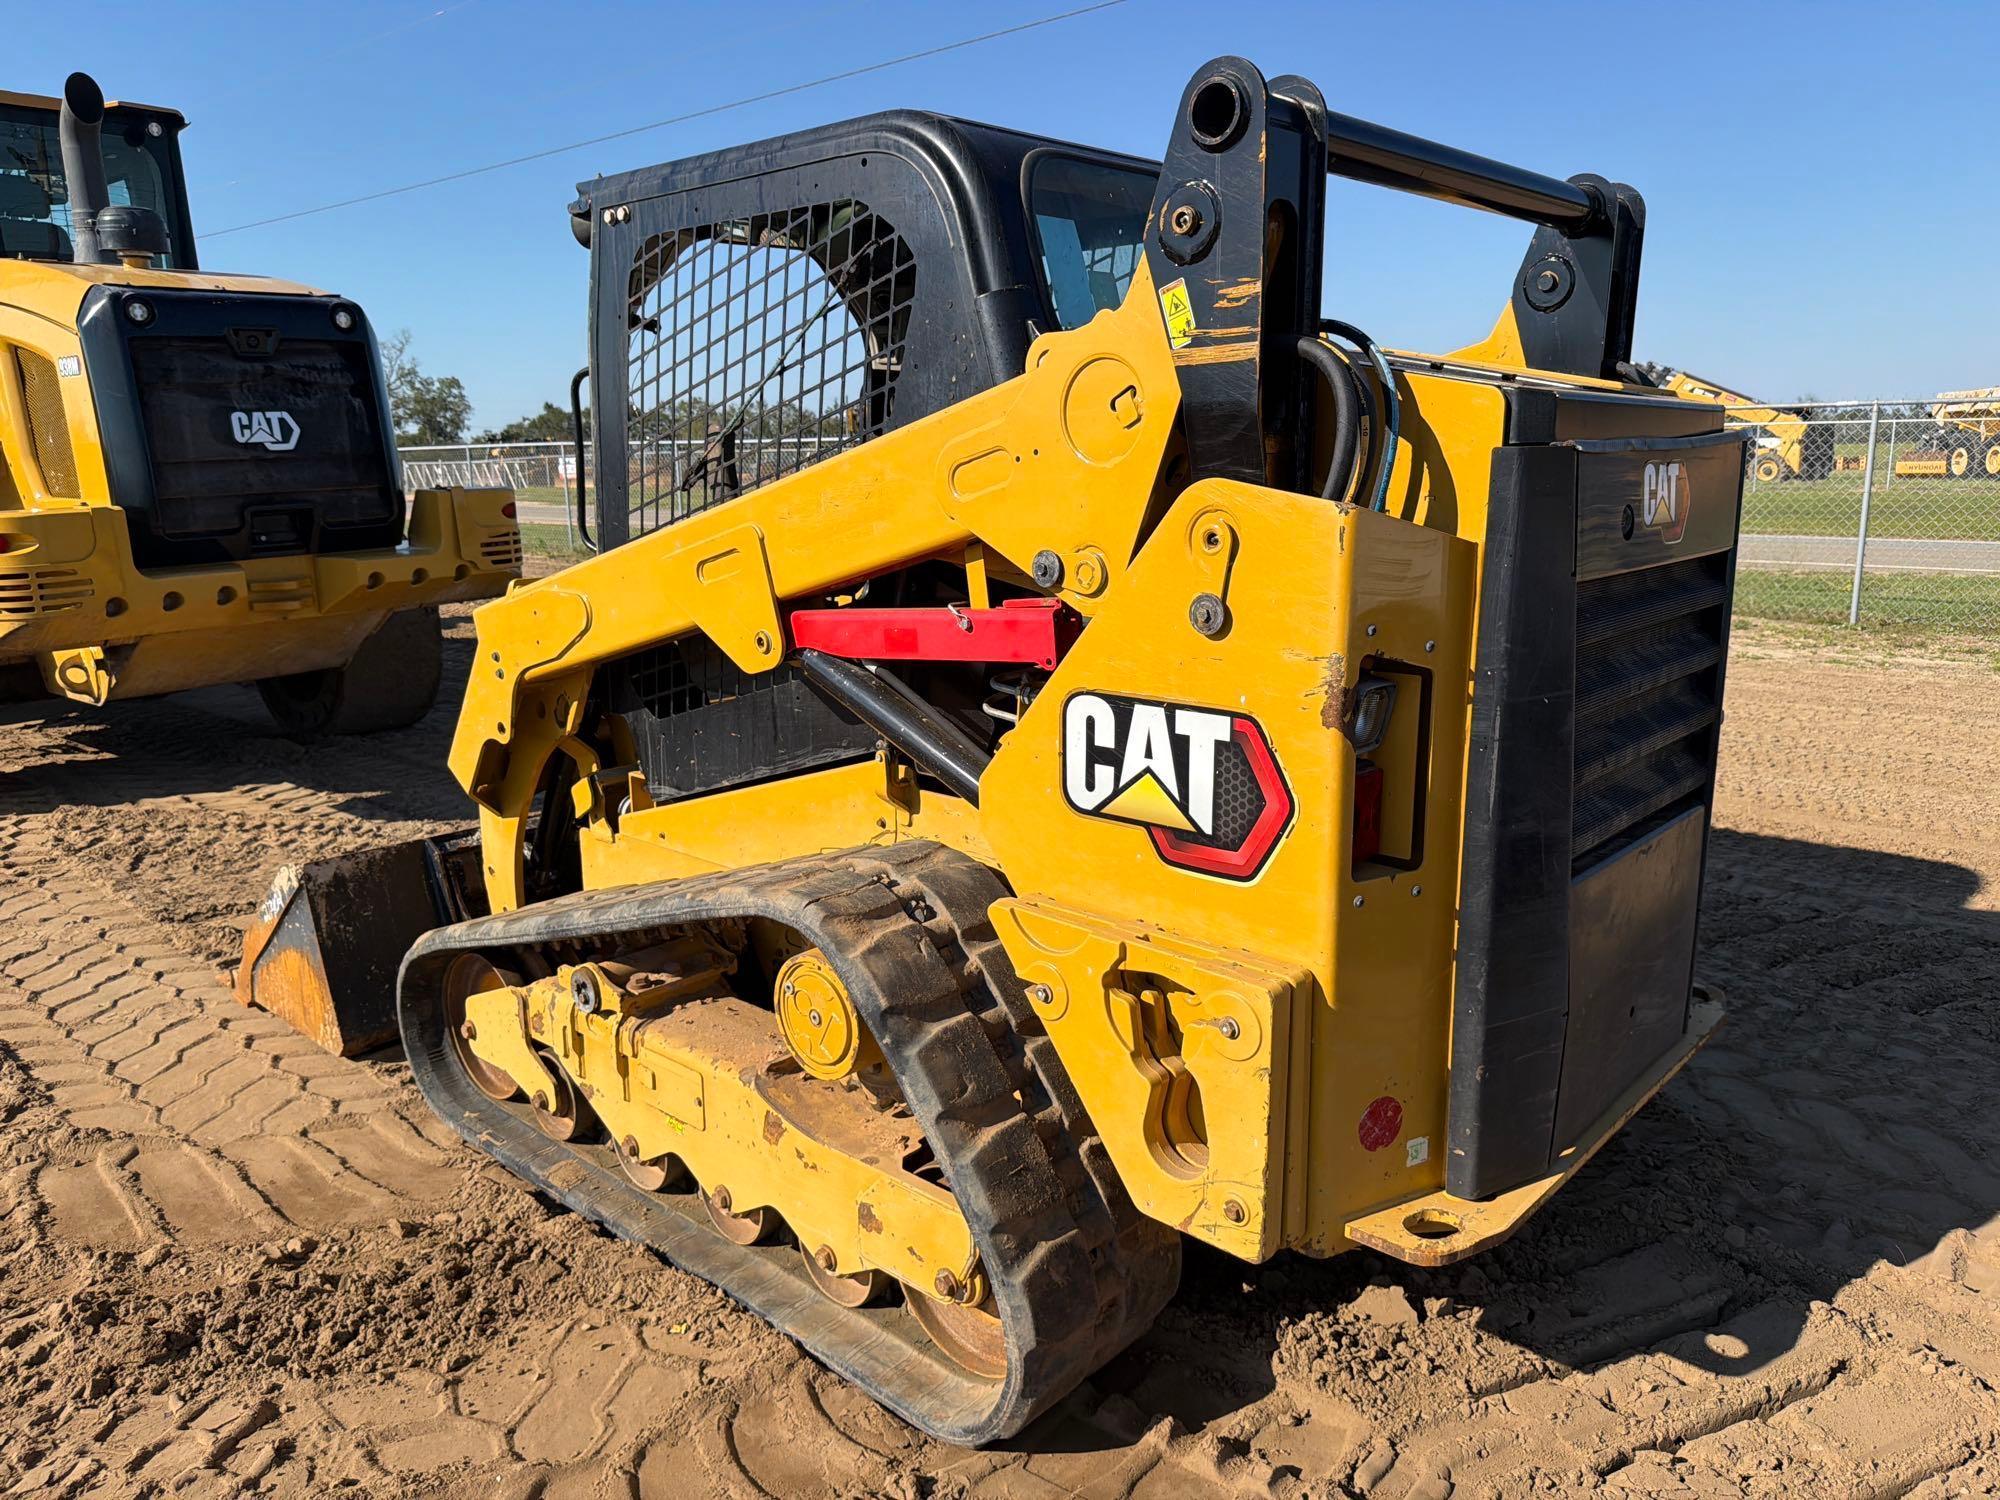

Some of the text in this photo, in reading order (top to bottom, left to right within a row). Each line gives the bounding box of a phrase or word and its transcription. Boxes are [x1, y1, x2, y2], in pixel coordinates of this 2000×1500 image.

[231, 411, 282, 443] CAT
[1644, 463, 1679, 526] CAT
[1066, 694, 1231, 835] CAT
